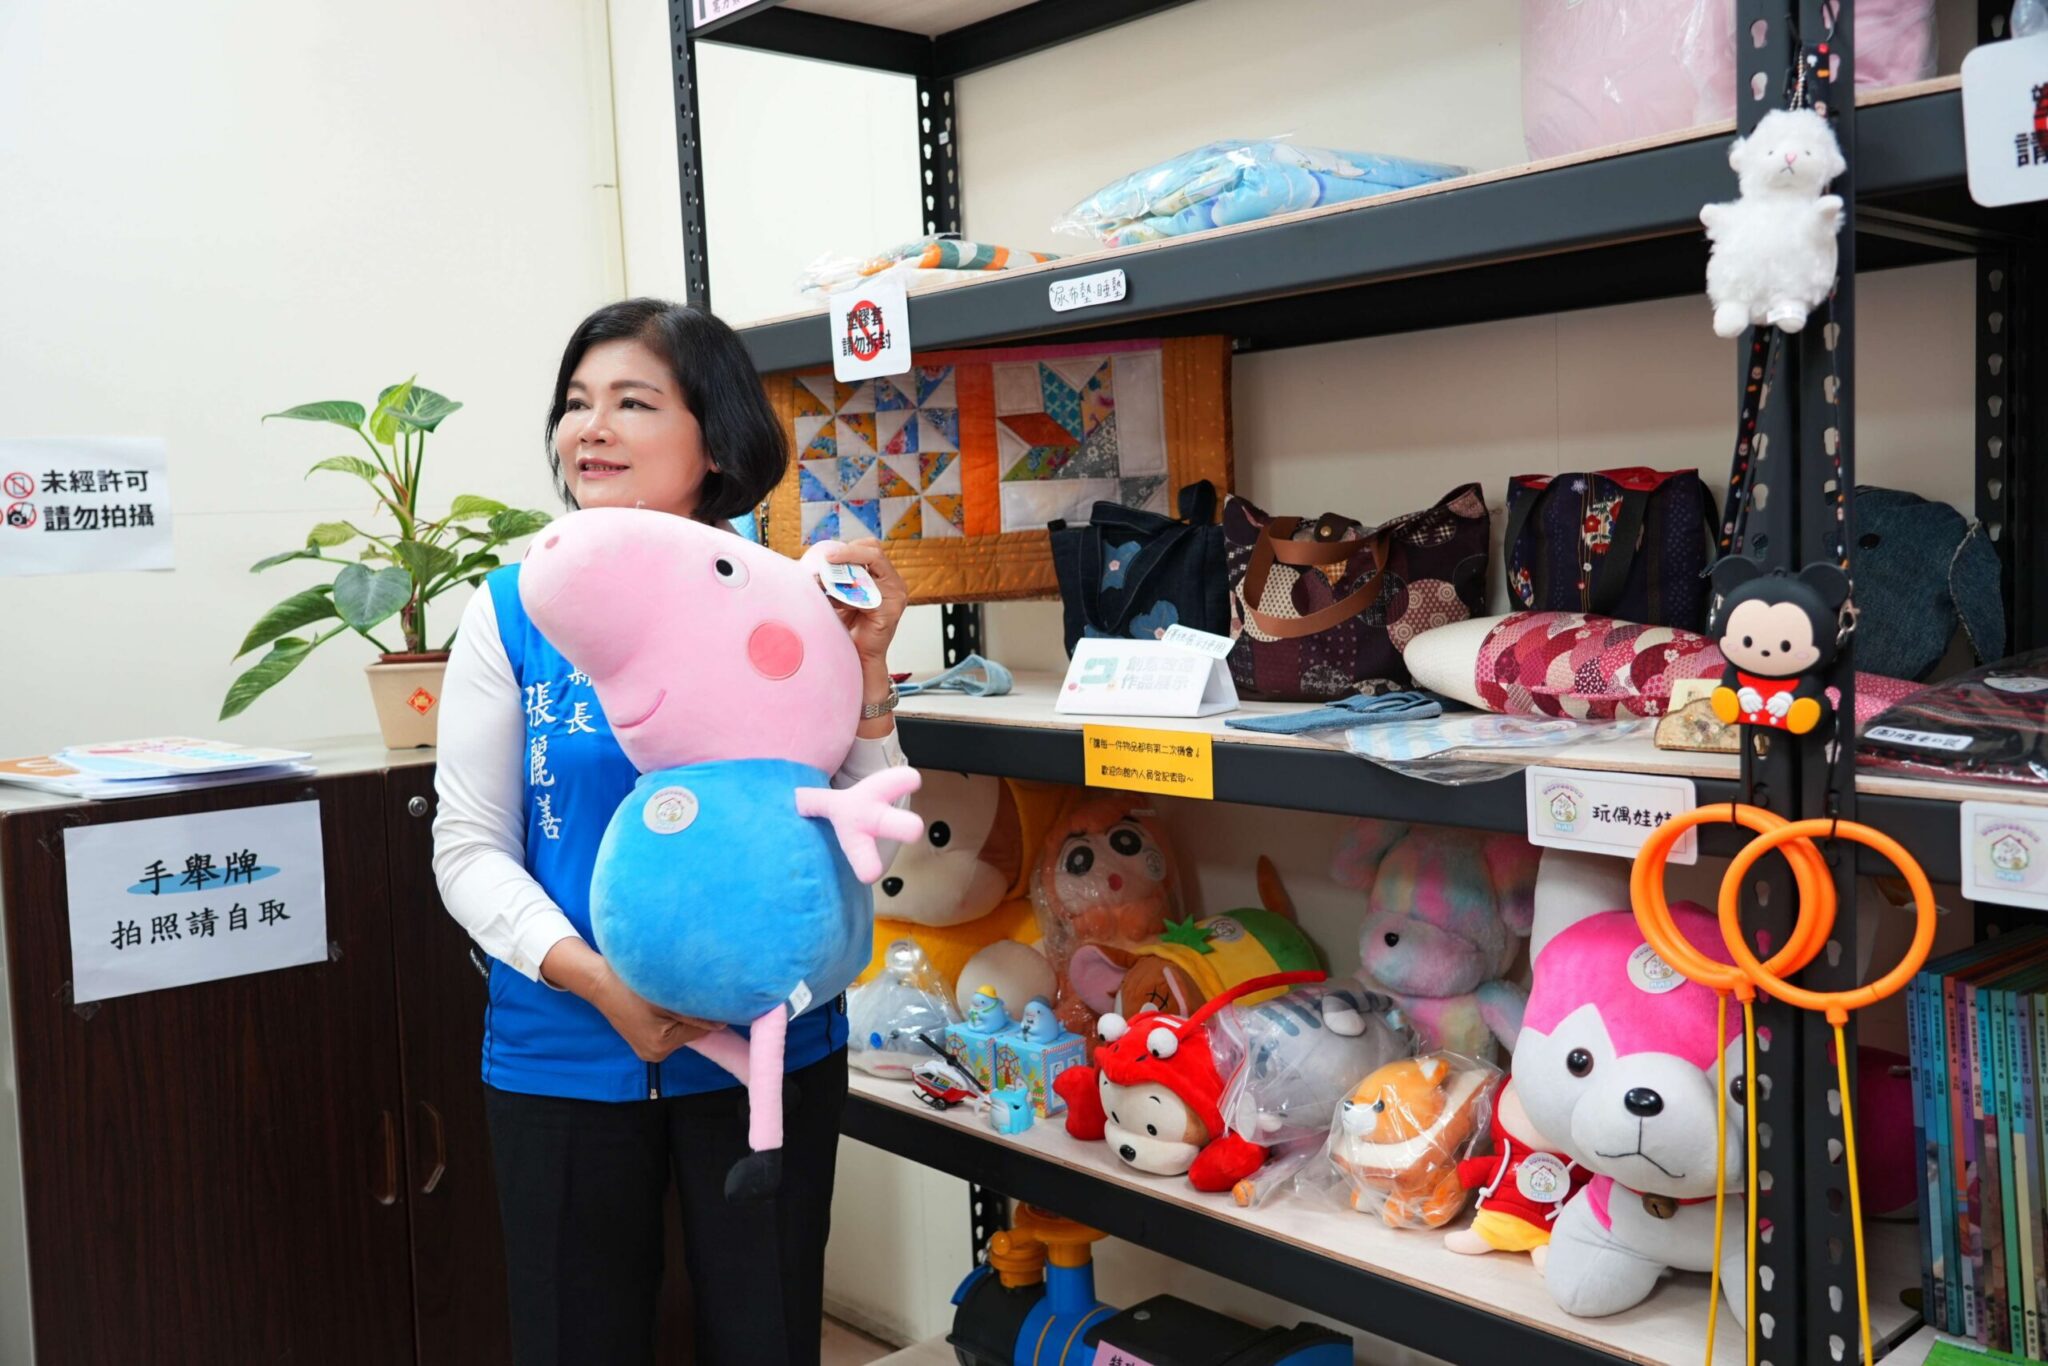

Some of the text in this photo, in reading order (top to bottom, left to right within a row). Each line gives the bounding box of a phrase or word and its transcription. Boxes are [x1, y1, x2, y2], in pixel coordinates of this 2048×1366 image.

[846, 306, 883, 331] 塑膠套
[841, 329, 891, 357] 請勿拆封
[41, 469, 149, 494] 未經許可
[44, 503, 155, 531] 請勿拍攝
[525, 681, 562, 840] 張麗善
[139, 848, 262, 896] 手舉牌
[110, 899, 291, 950] 拍照請自取
